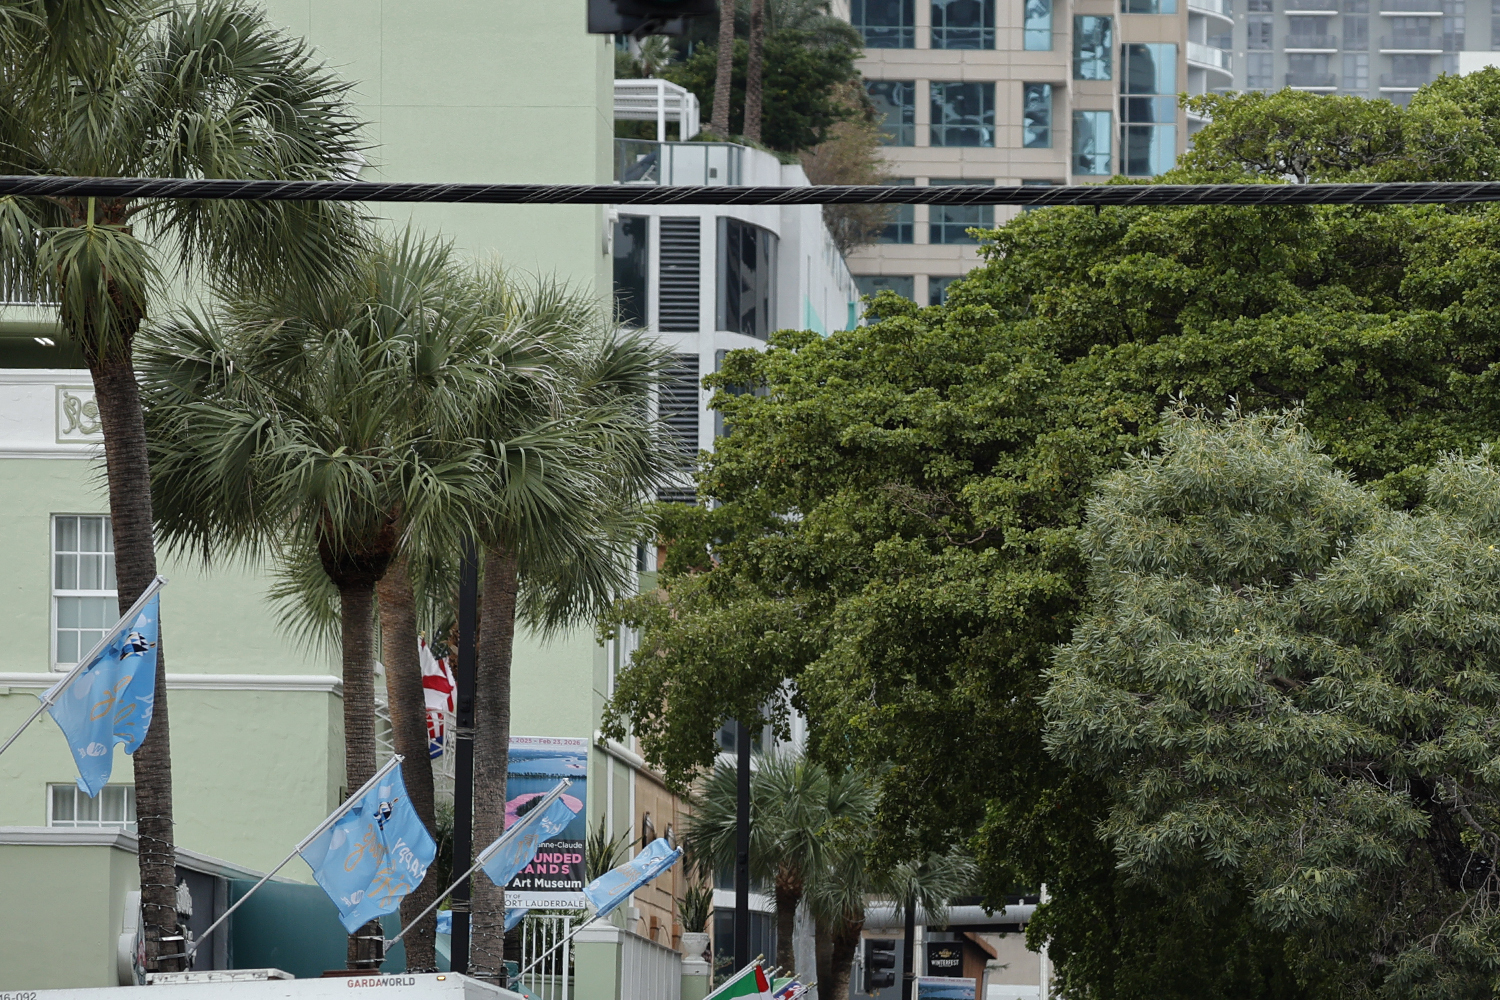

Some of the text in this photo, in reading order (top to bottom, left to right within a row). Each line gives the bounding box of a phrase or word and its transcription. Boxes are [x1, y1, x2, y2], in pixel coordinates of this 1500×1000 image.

[533, 852, 582, 864] UNDED
[519, 864, 570, 874] ANDS
[513, 878, 582, 888] Art Museum
[347, 978, 416, 988] GARDAWORLD
